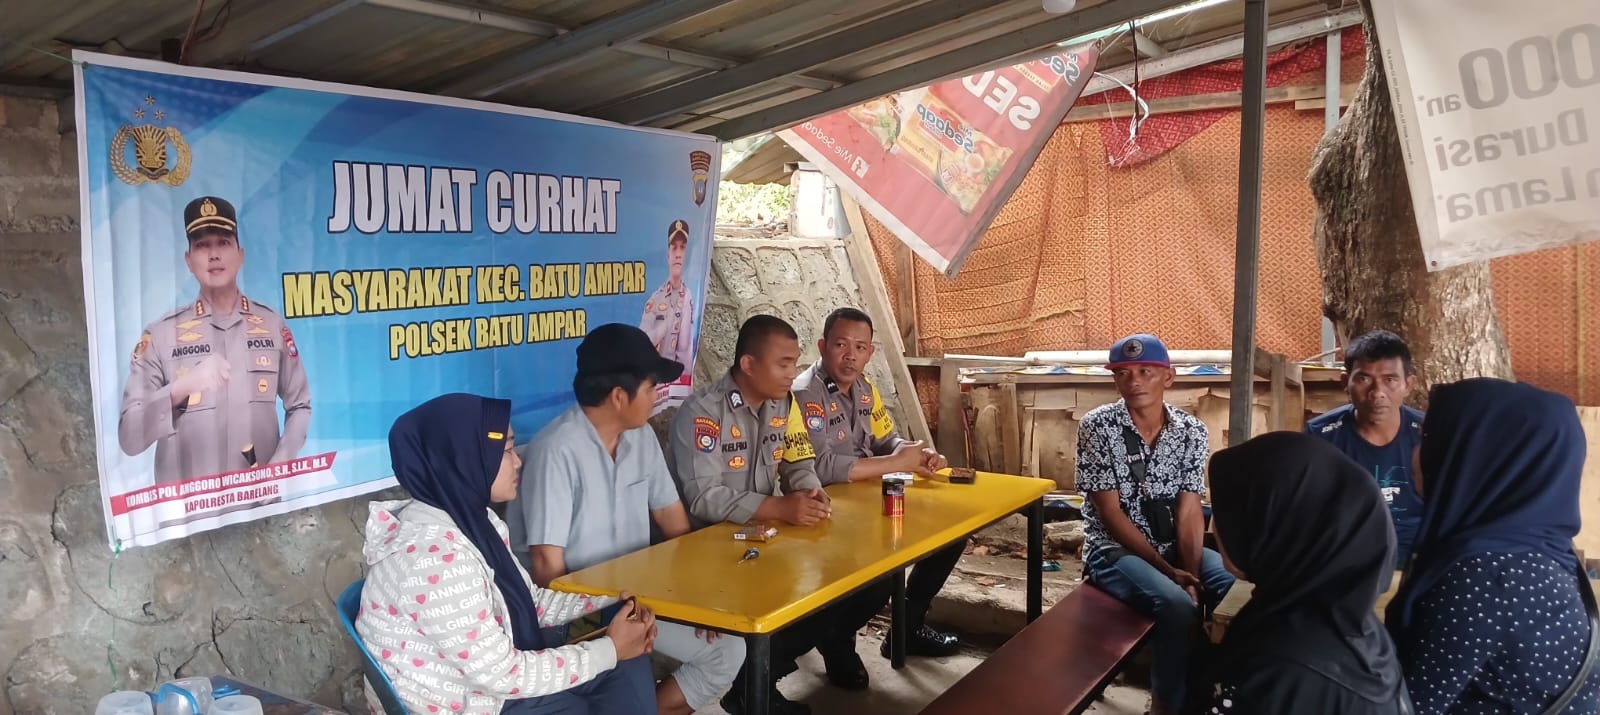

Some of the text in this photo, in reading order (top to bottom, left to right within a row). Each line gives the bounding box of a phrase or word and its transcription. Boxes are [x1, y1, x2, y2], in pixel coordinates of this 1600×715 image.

[328, 160, 622, 234] JUMAT CURHAT
[282, 260, 646, 319] MASYARAKAT KEC. BATU AMPAR
[247, 339, 275, 350] POLRI
[389, 309, 588, 360] POLSEK BATU AMPAR
[172, 344, 211, 358] ANGGORO
[158, 486, 178, 499] POL
[180, 478, 221, 496] ANGGORO
[184, 484, 280, 513] KAPOLRESTA BARELANG
[429, 581, 472, 602] ANNIL
[446, 613, 477, 631] GIRL
[405, 640, 437, 656] GIRL
